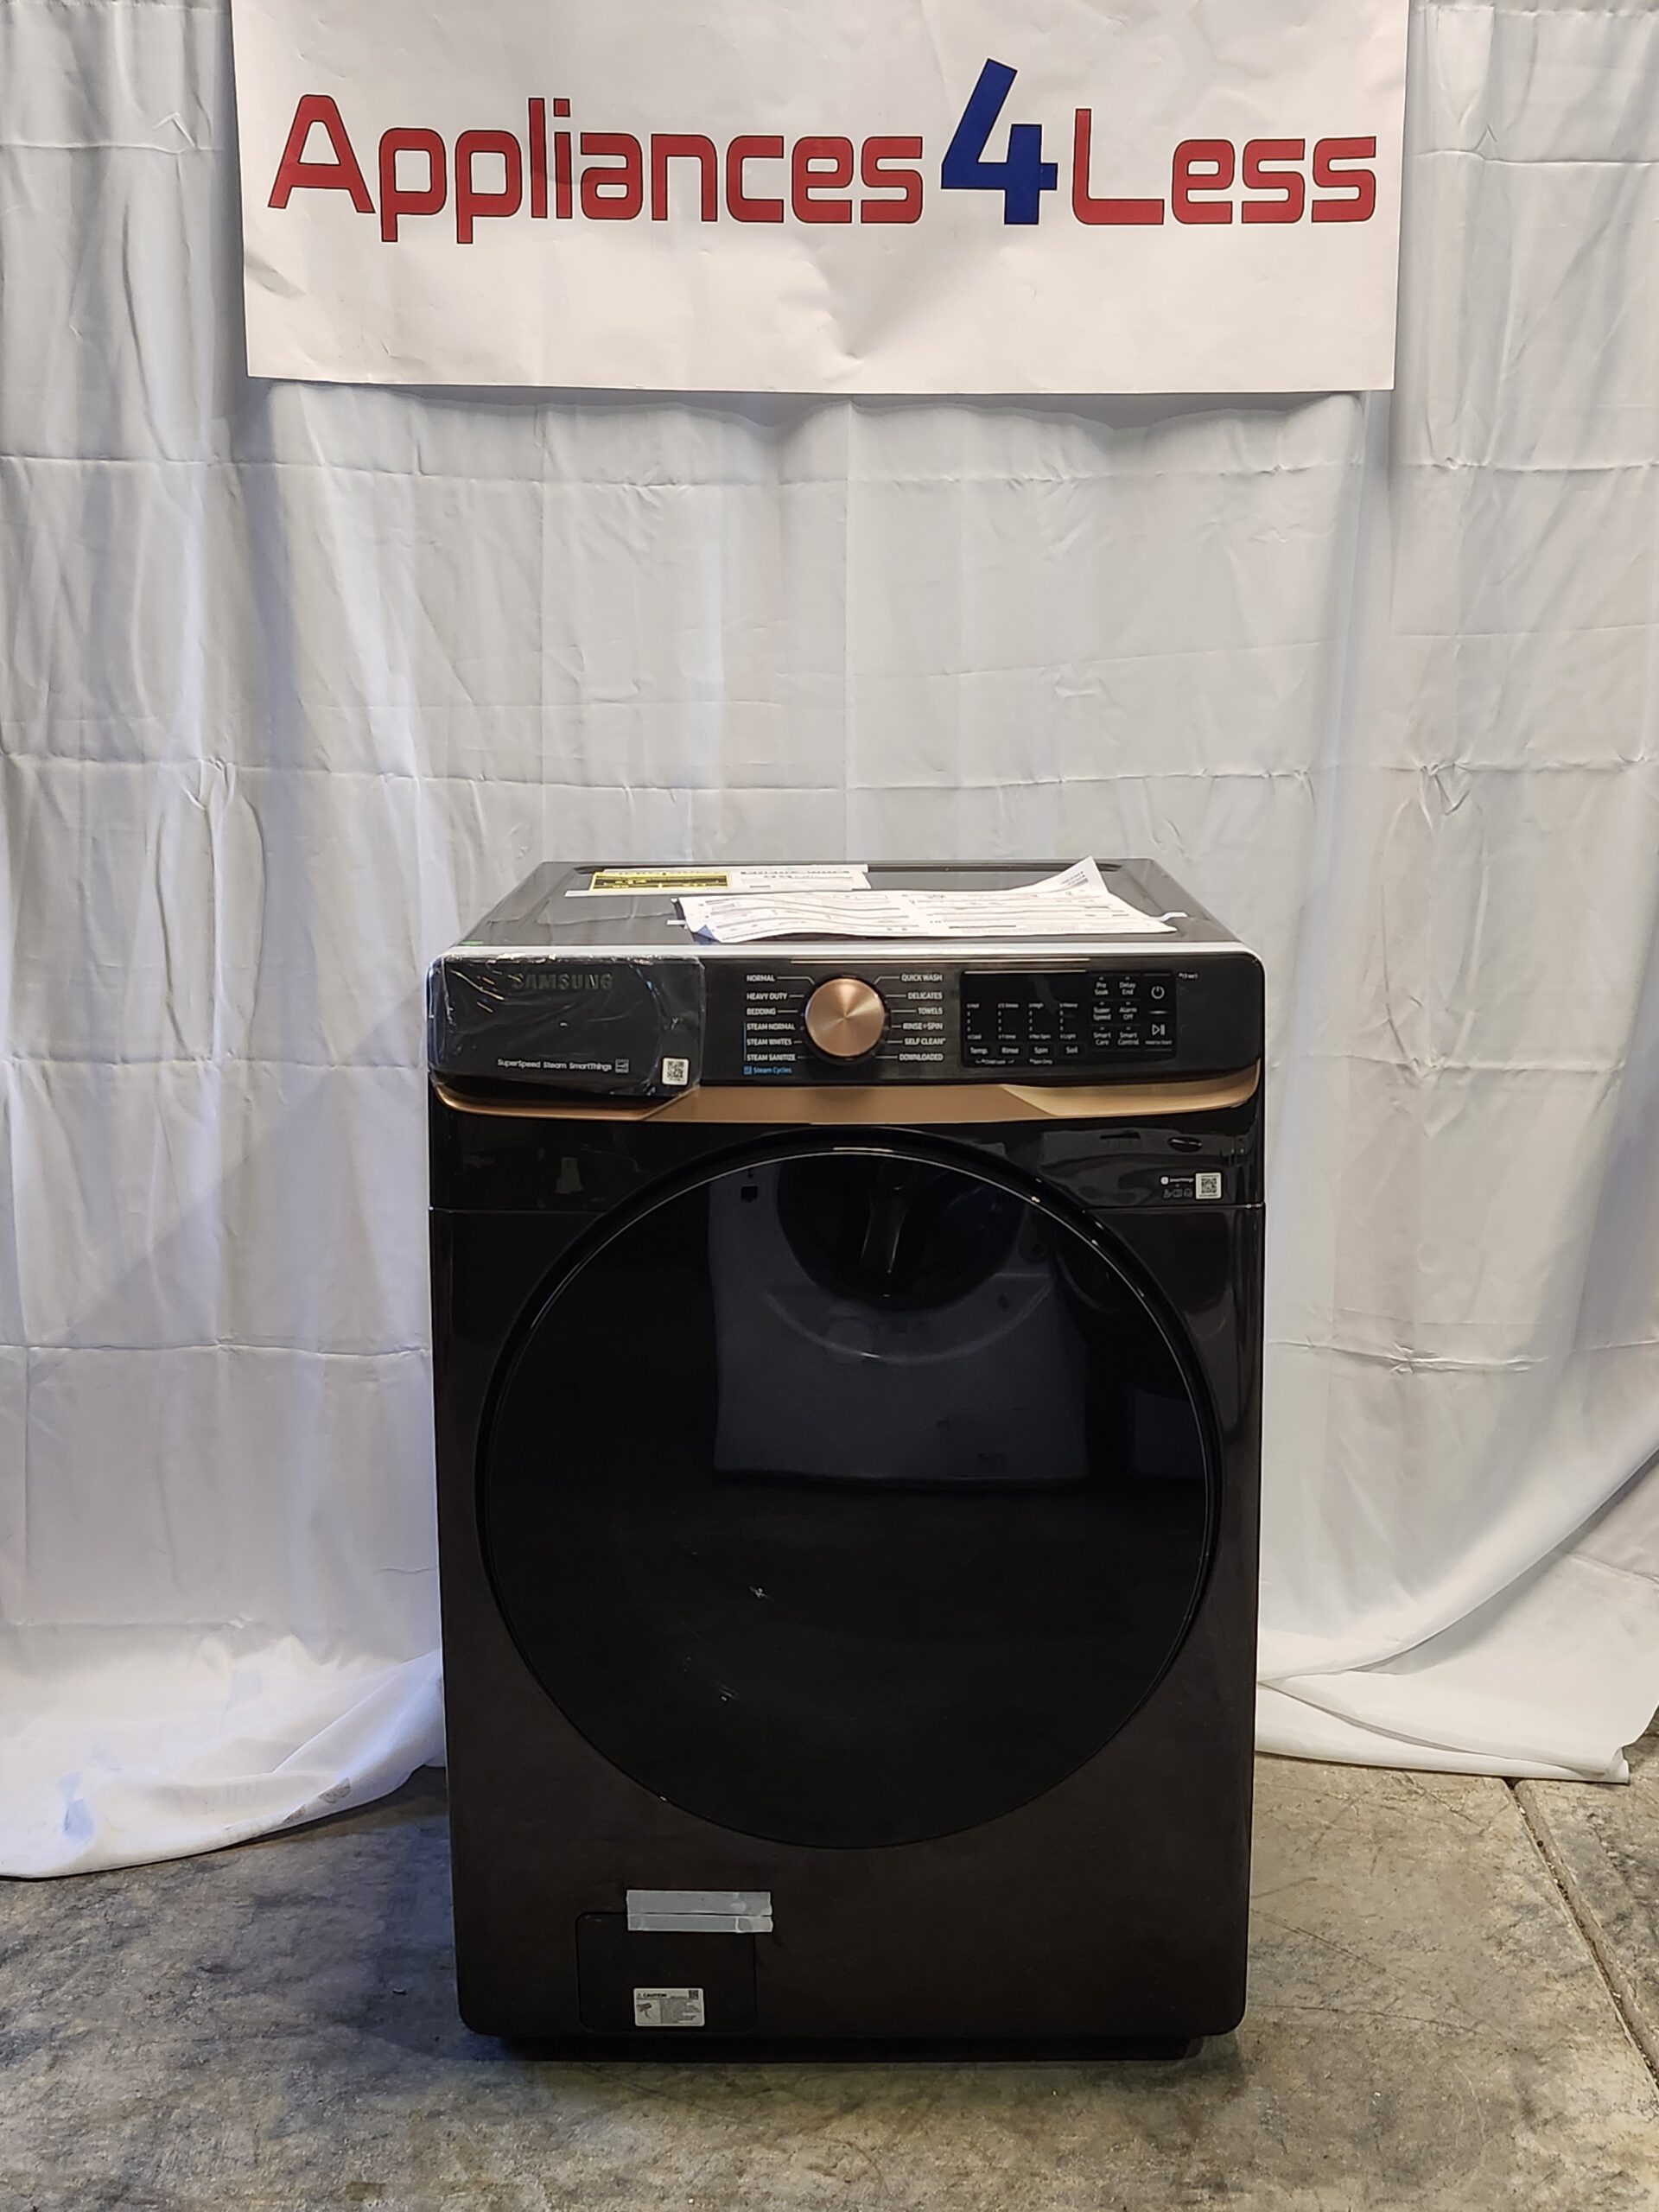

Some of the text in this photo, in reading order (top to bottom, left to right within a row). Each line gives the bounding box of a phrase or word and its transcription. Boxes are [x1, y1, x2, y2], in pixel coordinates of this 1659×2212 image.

[512, 973, 613, 989] SAMSUNG
[497, 1058, 541, 1069] SuperSpeed
[569, 1062, 613, 1071] SmartThings
